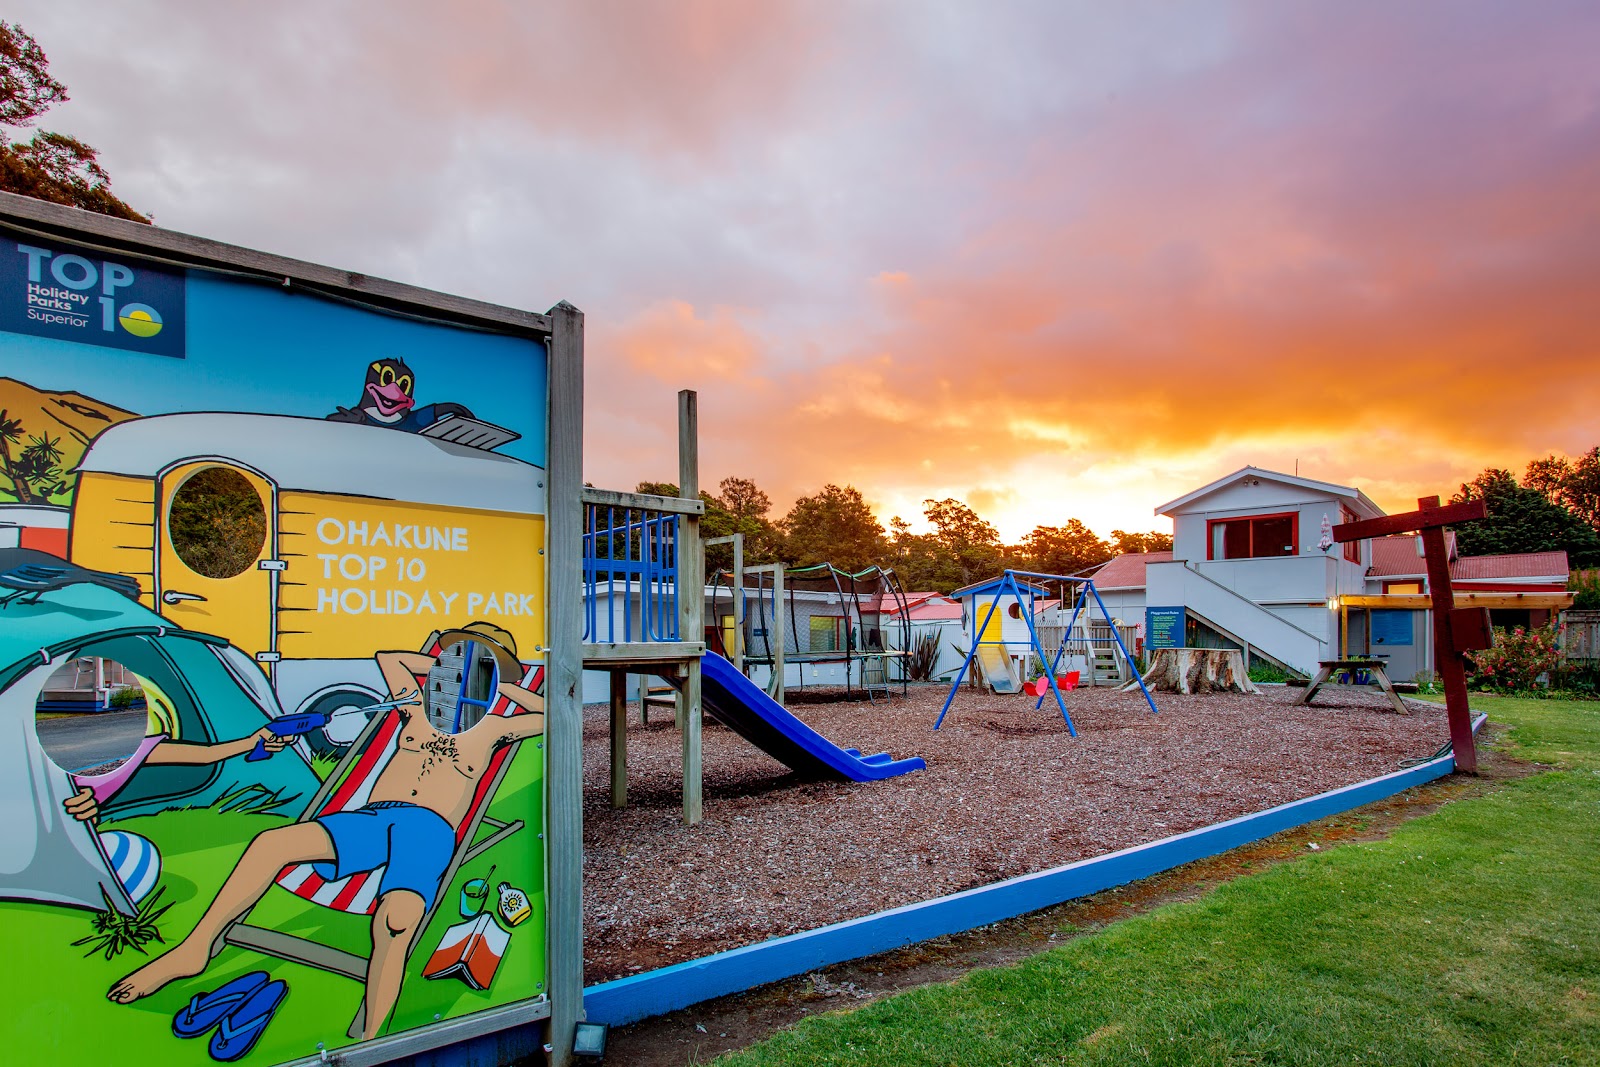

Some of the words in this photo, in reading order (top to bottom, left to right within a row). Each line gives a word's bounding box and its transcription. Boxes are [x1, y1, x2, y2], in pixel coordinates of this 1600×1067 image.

[18, 244, 135, 296] TOP
[27, 283, 89, 305] Holiday
[27, 294, 72, 311] Parks
[28, 309, 88, 328] Superior
[99, 296, 164, 338] 10
[316, 517, 469, 552] OHAKUNE
[317, 553, 387, 581] TOP
[396, 557, 427, 582] 10
[316, 587, 459, 616] HOLIDAY
[467, 592, 535, 616] PARK
